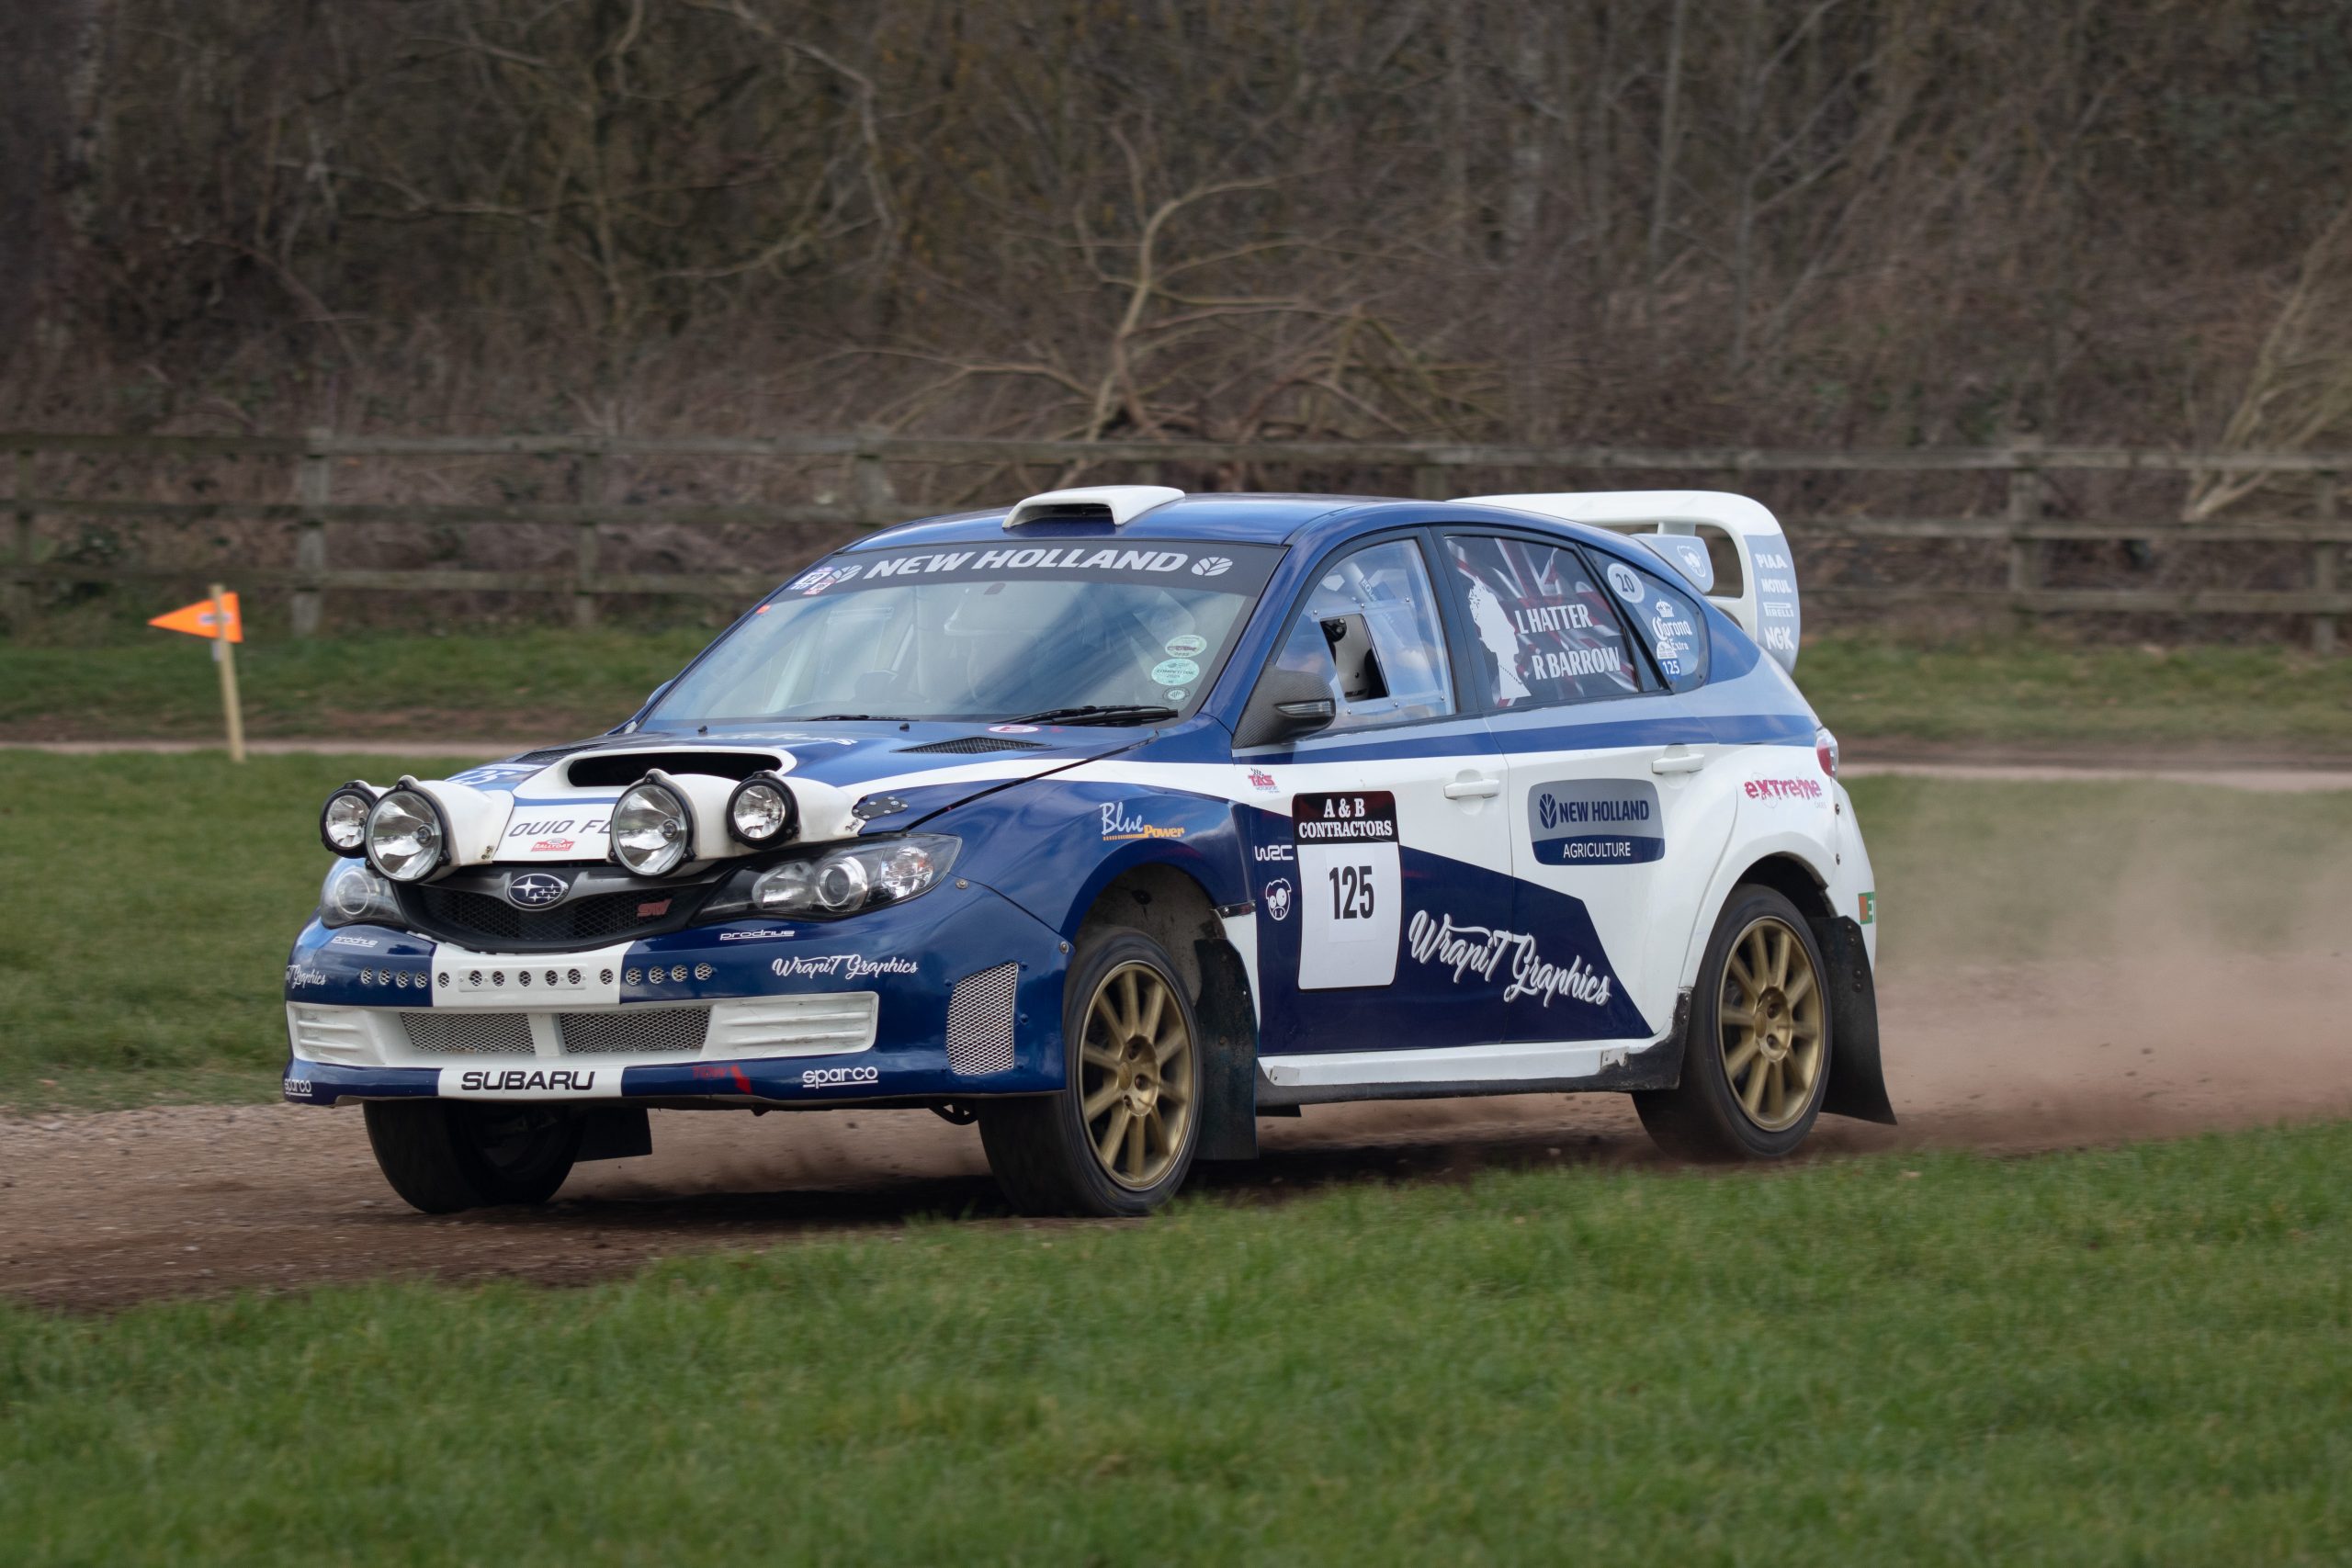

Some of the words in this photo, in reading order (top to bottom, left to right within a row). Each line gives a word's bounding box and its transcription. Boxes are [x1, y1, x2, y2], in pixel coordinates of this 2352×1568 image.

[863, 552, 967, 581] NEW
[970, 549, 1188, 572] HOLLAND
[1755, 553, 1788, 569] PIAA
[1615, 573, 1634, 593] 20
[1761, 579, 1792, 594] MOTUL
[1515, 609, 1529, 635] L
[1531, 604, 1592, 633] HATTER
[1763, 602, 1793, 617] PIRELLI
[1652, 616, 1692, 641] Corona
[1764, 626, 1793, 650] NGK
[1668, 638, 1689, 651] Extra
[1532, 656, 1546, 680] R
[1547, 647, 1622, 678] BARROW
[1662, 660, 1679, 675] 125
[1323, 799, 1335, 818] A
[1338, 798, 1351, 818] &
[1355, 798, 1365, 818] B
[1559, 802, 1589, 824] NEW
[1591, 799, 1649, 822] HOLLAND
[1100, 802, 1144, 835] Blue
[1298, 821, 1393, 839] CONTRACTORS
[1254, 845, 1294, 861] WRC
[1563, 841, 1631, 859] AGRICULTURE
[1329, 865, 1374, 919] 125
[720, 930, 796, 941] prodrive
[844, 953, 918, 979] Graphics
[1503, 934, 1611, 1008] Graphics
[284, 1078, 312, 1096] sparco
[461, 1071, 594, 1091] SUBARU
[802, 1066, 878, 1089] sparco
